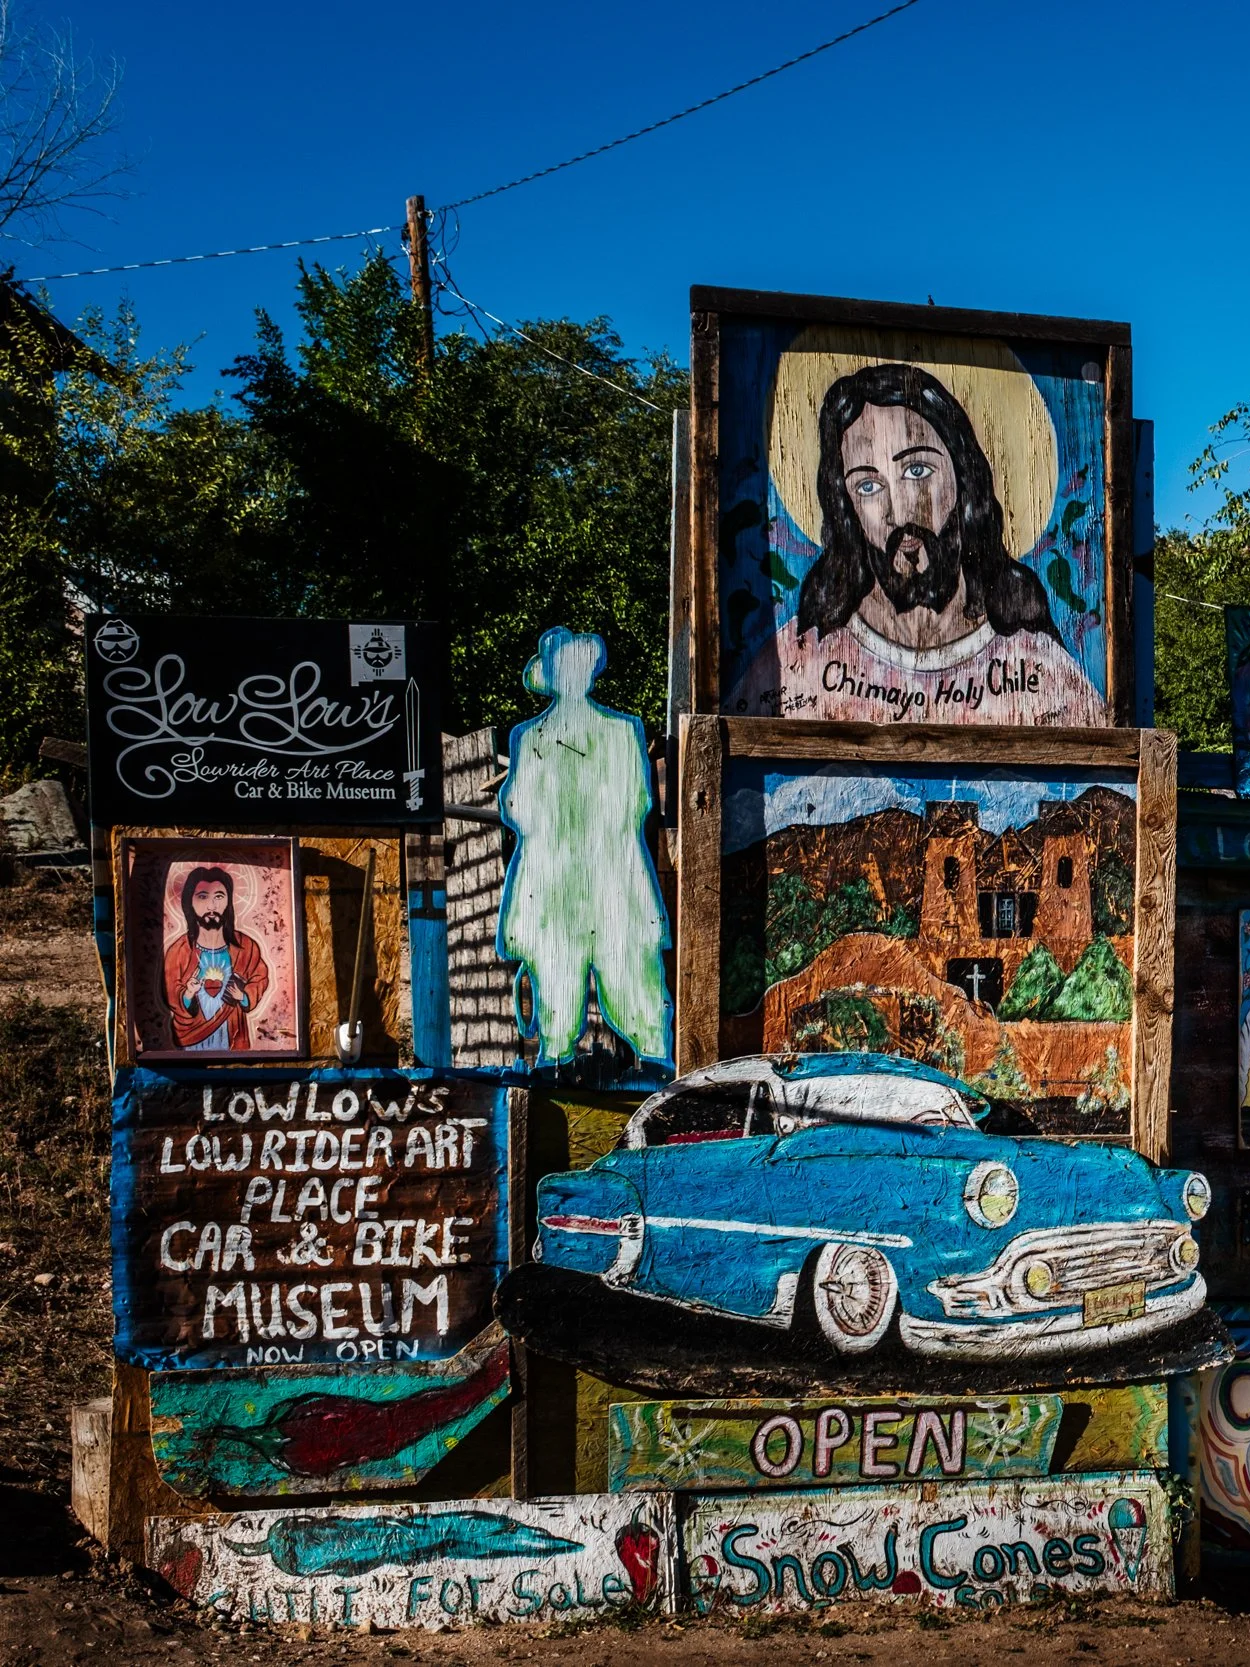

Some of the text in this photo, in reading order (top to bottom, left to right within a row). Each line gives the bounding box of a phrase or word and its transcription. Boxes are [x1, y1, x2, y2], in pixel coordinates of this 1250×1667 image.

[103, 654, 238, 746] Low
[821, 659, 926, 722] Chimayo
[934, 677, 984, 710] Holy
[986, 658, 1040, 696] Chile
[171, 747, 396, 783] Lowrider Art Place
[234, 781, 397, 800] Car & Bike Museum
[160, 1117, 489, 1174] LOWRIDER ART
[241, 1175, 384, 1223] PLACE
[160, 1217, 475, 1272] CAR & BIKE
[201, 1273, 451, 1344] MUSEUM
[245, 1339, 420, 1365] NOW OPEN
[750, 1404, 968, 1481] OPEN
[919, 1516, 1105, 1590] Cones
[506, 1568, 635, 1618] Sale
